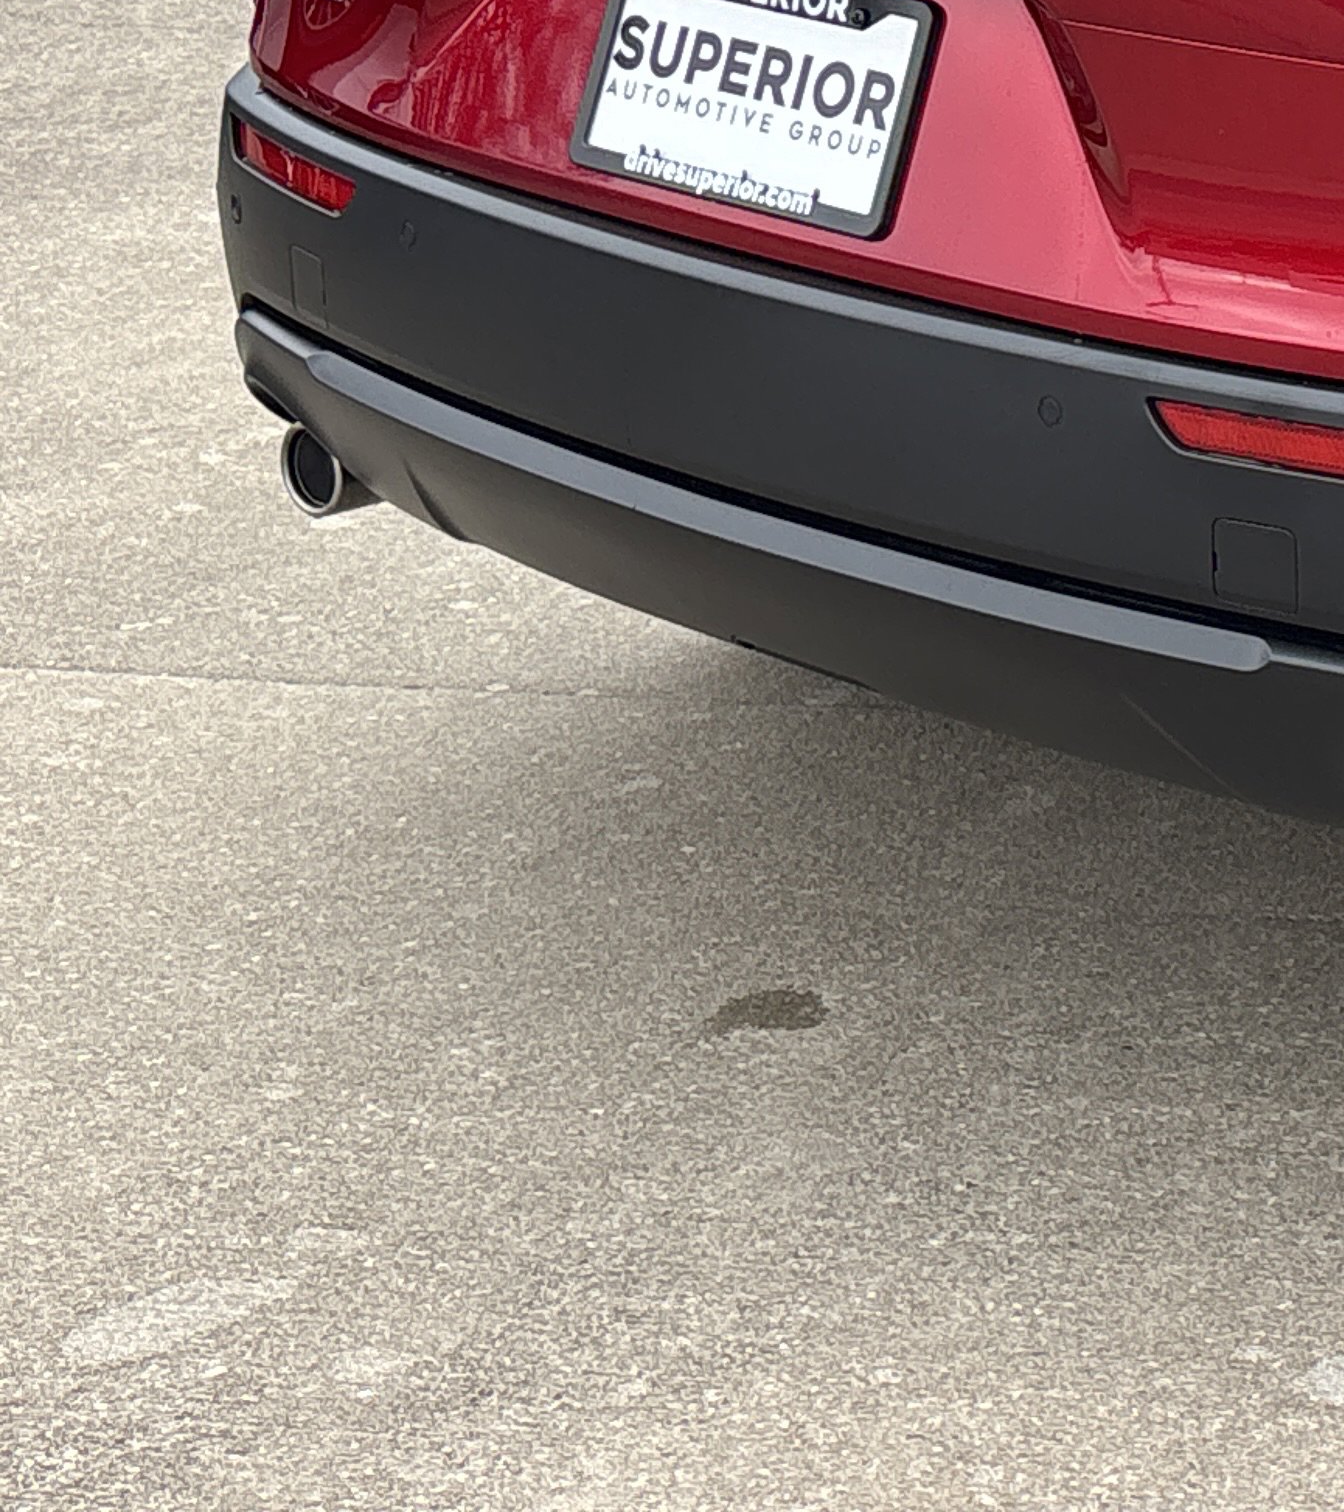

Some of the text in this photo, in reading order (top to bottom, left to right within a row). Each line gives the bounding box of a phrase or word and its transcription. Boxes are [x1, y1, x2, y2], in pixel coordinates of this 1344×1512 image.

[606, 77, 882, 160] AUTOMOTIVE GROUP
[612, 14, 896, 131] SUPERIOR
